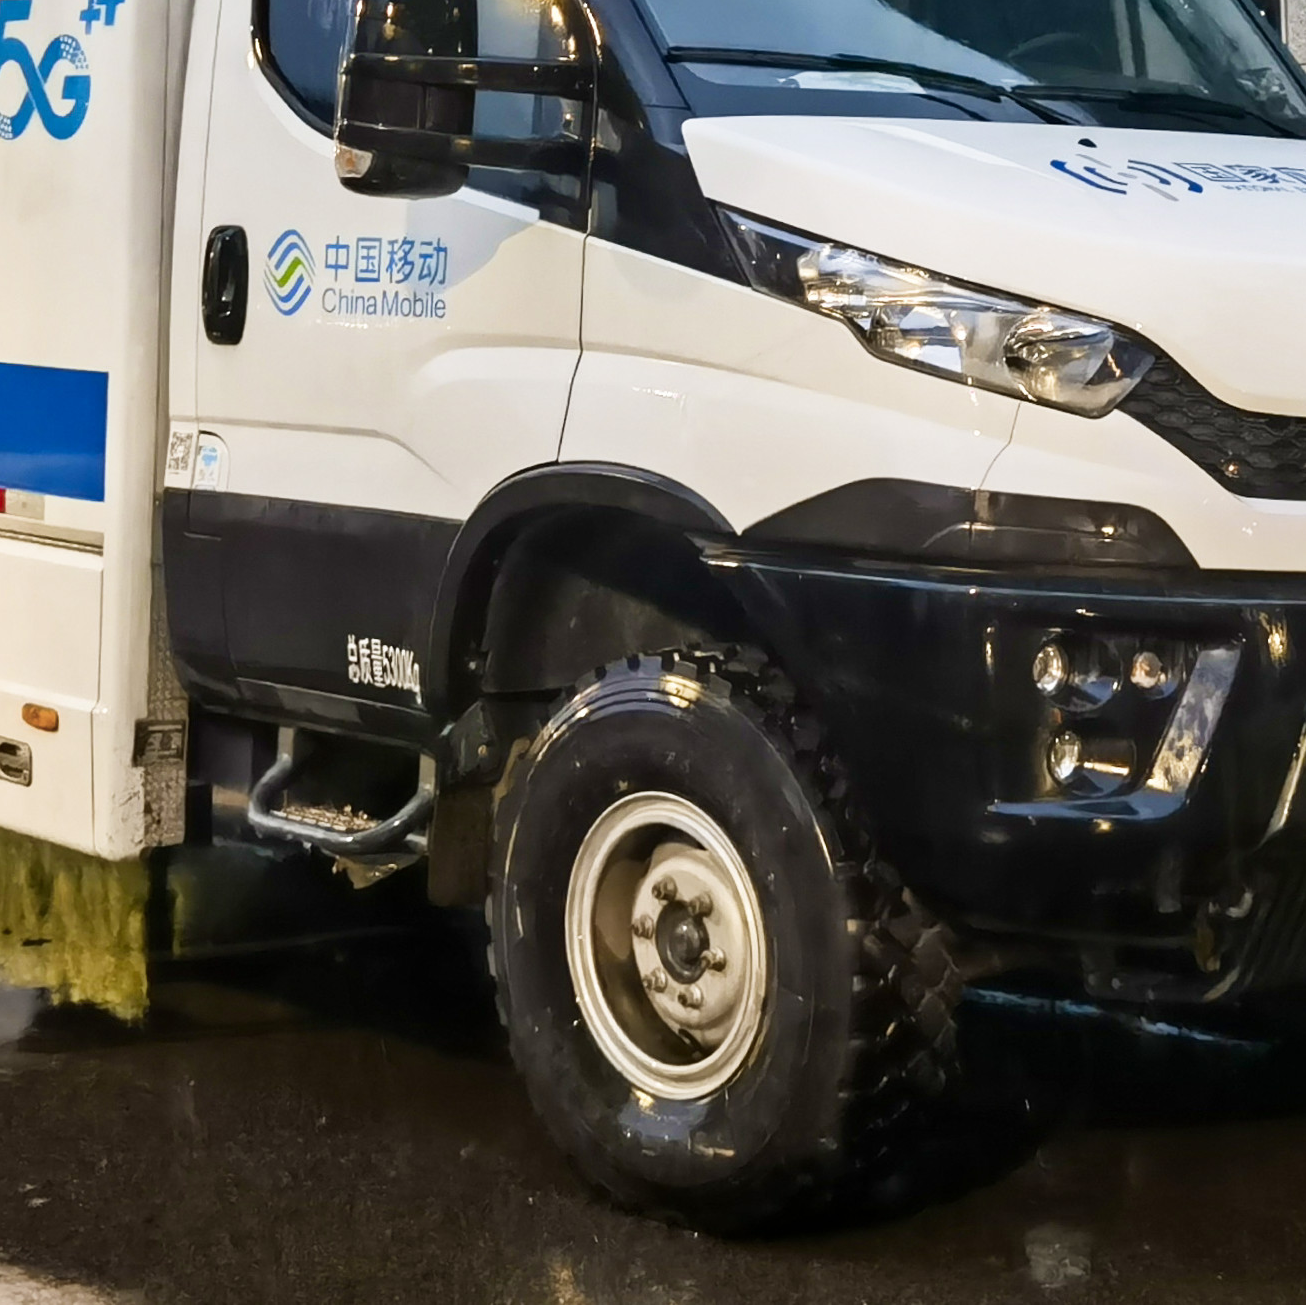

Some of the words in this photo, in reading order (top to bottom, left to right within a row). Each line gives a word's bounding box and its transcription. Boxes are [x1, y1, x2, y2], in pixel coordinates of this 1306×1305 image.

[324, 235, 448, 286] 中国移动
[321, 287, 378, 315] China
[381, 290, 447, 319] Mobile
